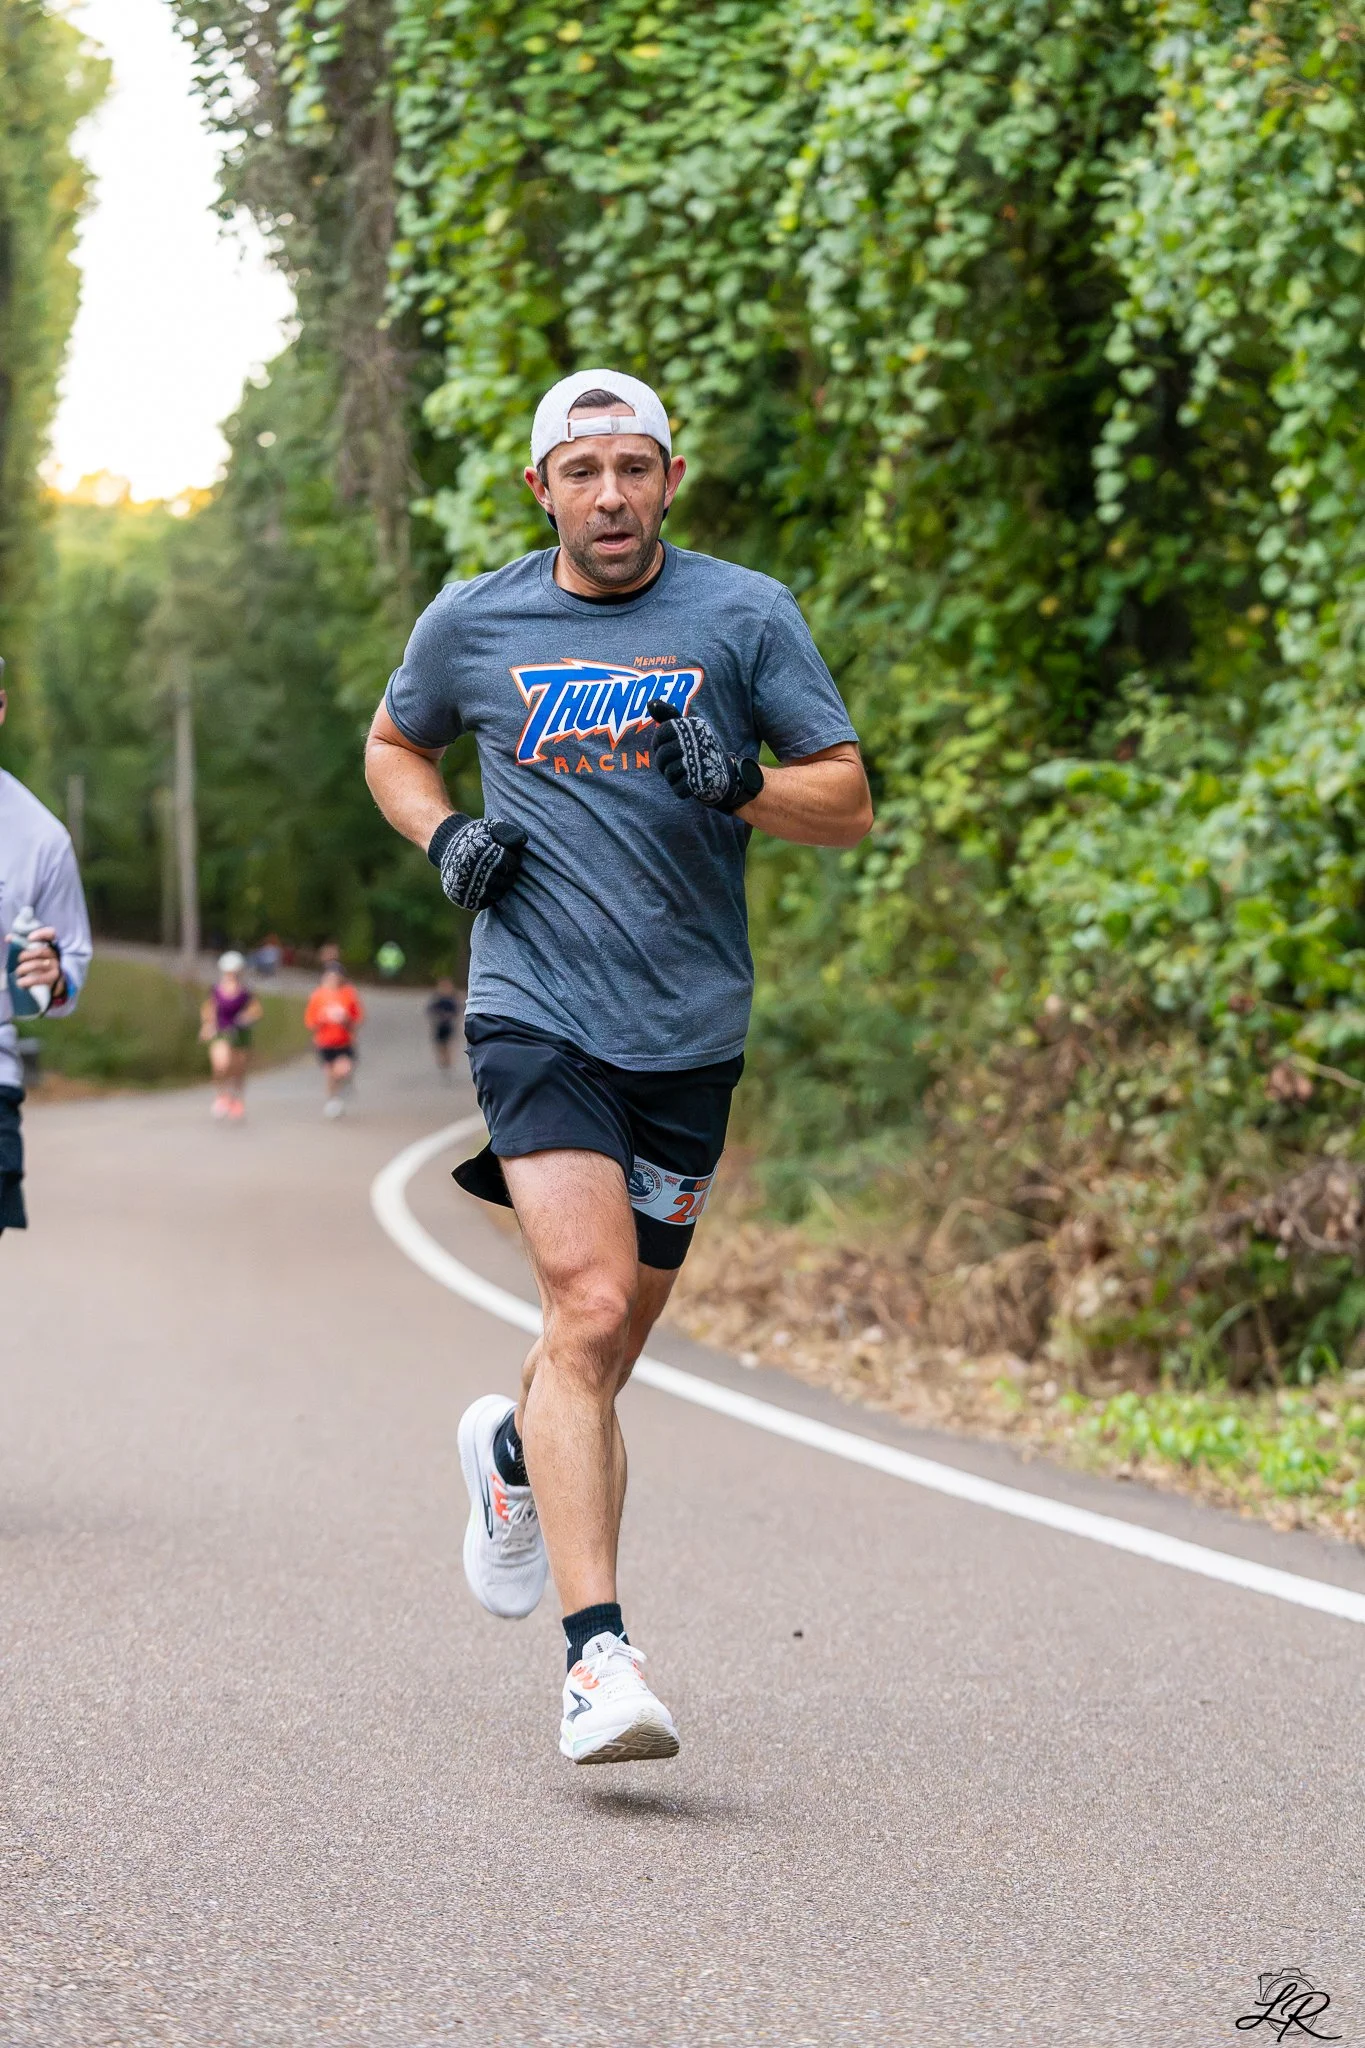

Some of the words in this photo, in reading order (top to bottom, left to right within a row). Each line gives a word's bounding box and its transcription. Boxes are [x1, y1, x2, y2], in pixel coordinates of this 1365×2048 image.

[633, 655, 677, 667] MEMPHIS
[509, 658, 704, 766] THUNDER
[553, 750, 650, 775] RACIN
